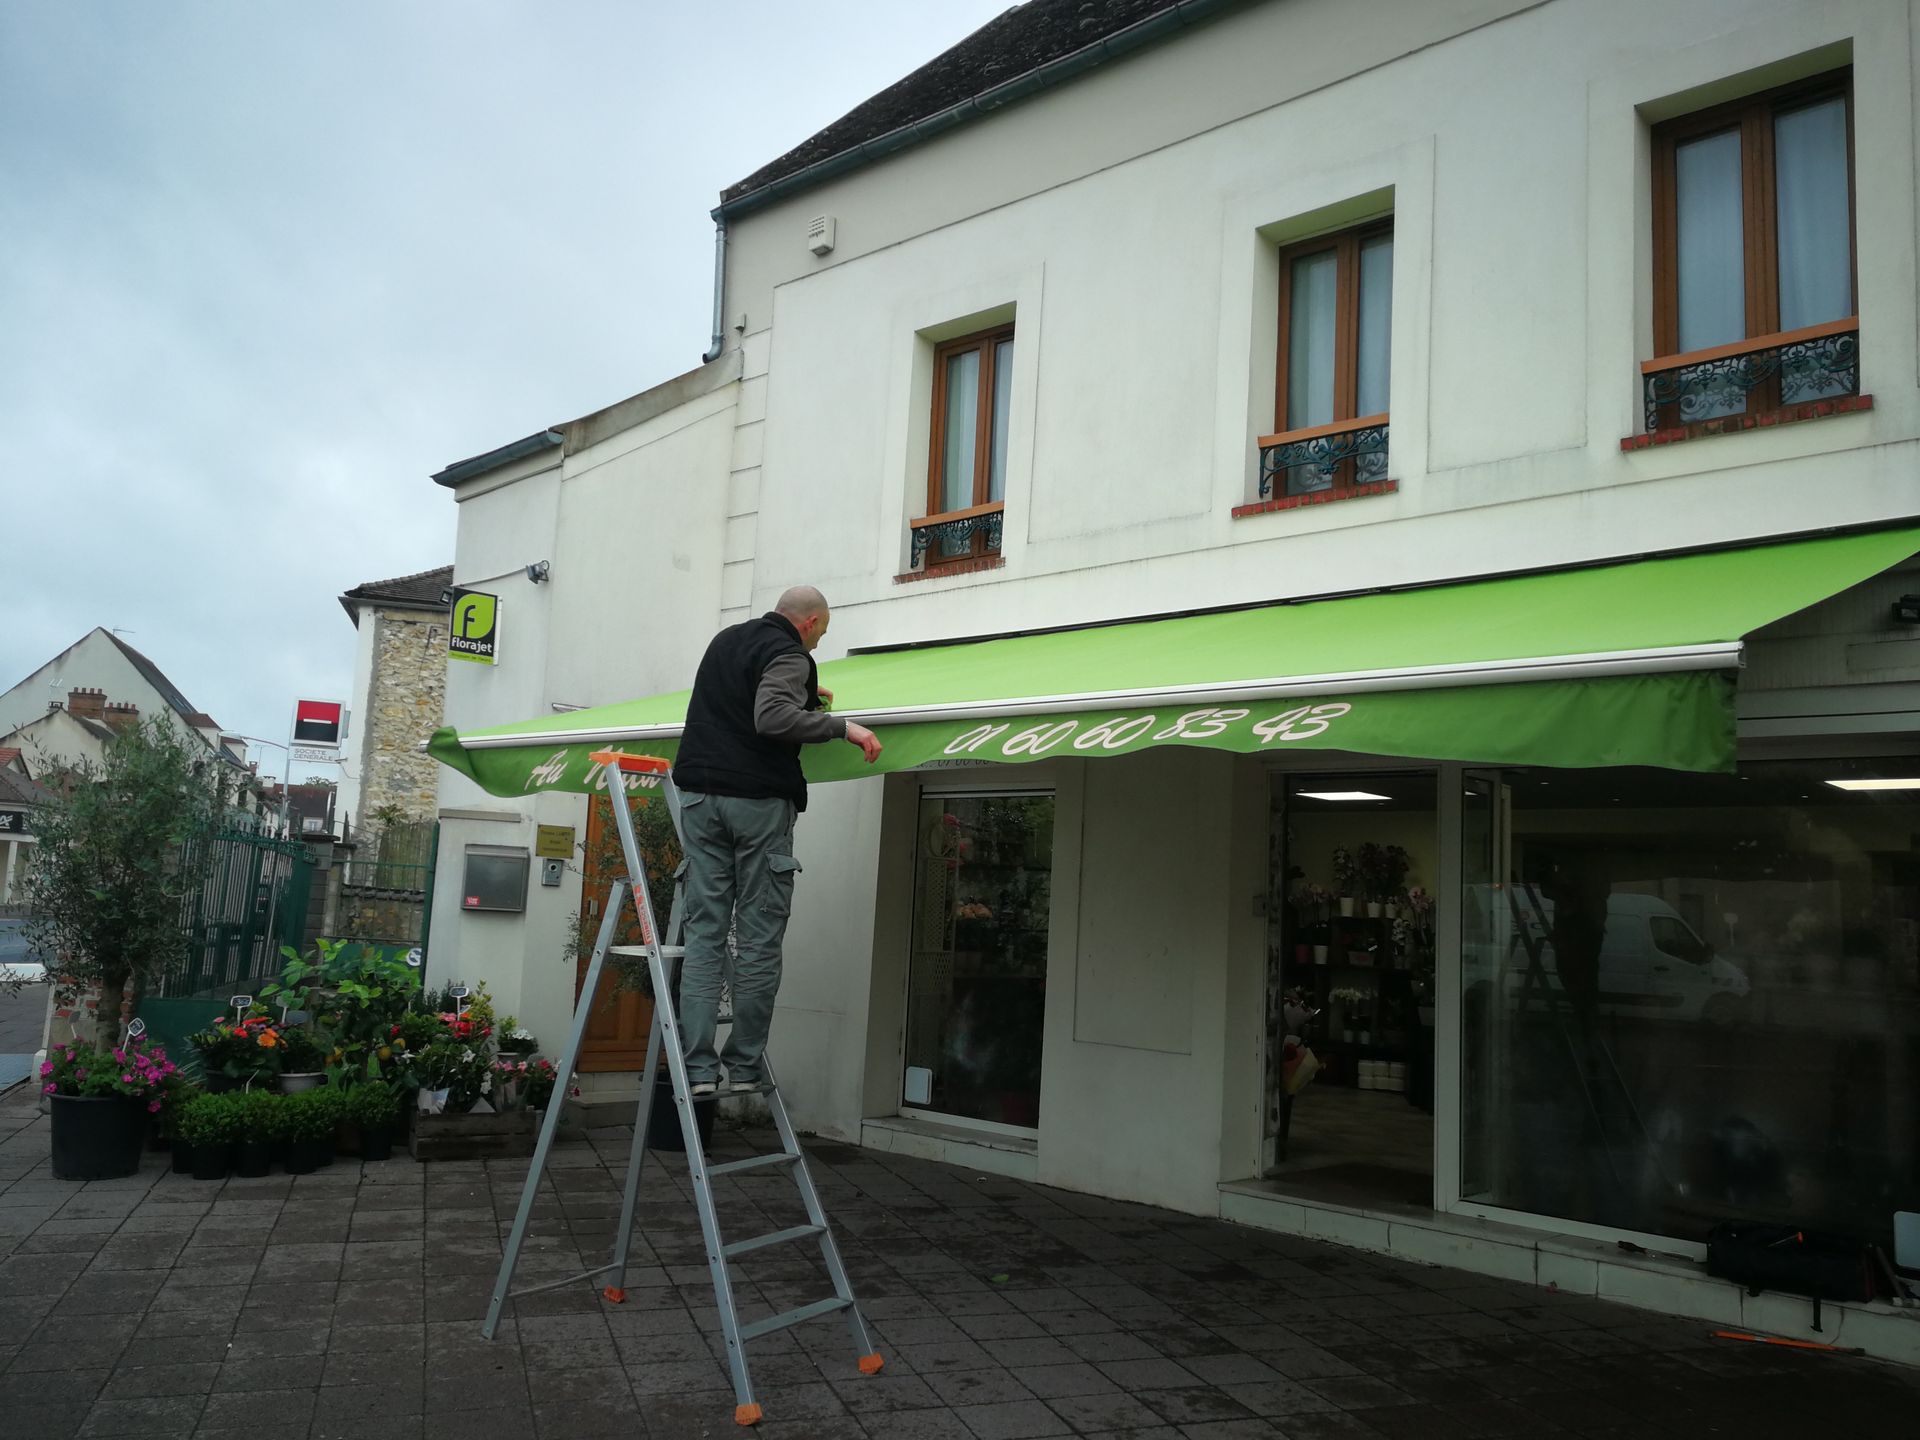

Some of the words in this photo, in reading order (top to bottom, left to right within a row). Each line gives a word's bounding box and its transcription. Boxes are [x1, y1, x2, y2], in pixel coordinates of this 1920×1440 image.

[451, 636, 493, 653] florajet
[944, 723, 1010, 754] 01
[1002, 719, 1079, 756] 60
[1073, 714, 1156, 749] 60
[1152, 708, 1250, 740] 83
[1252, 702, 1352, 744] 43
